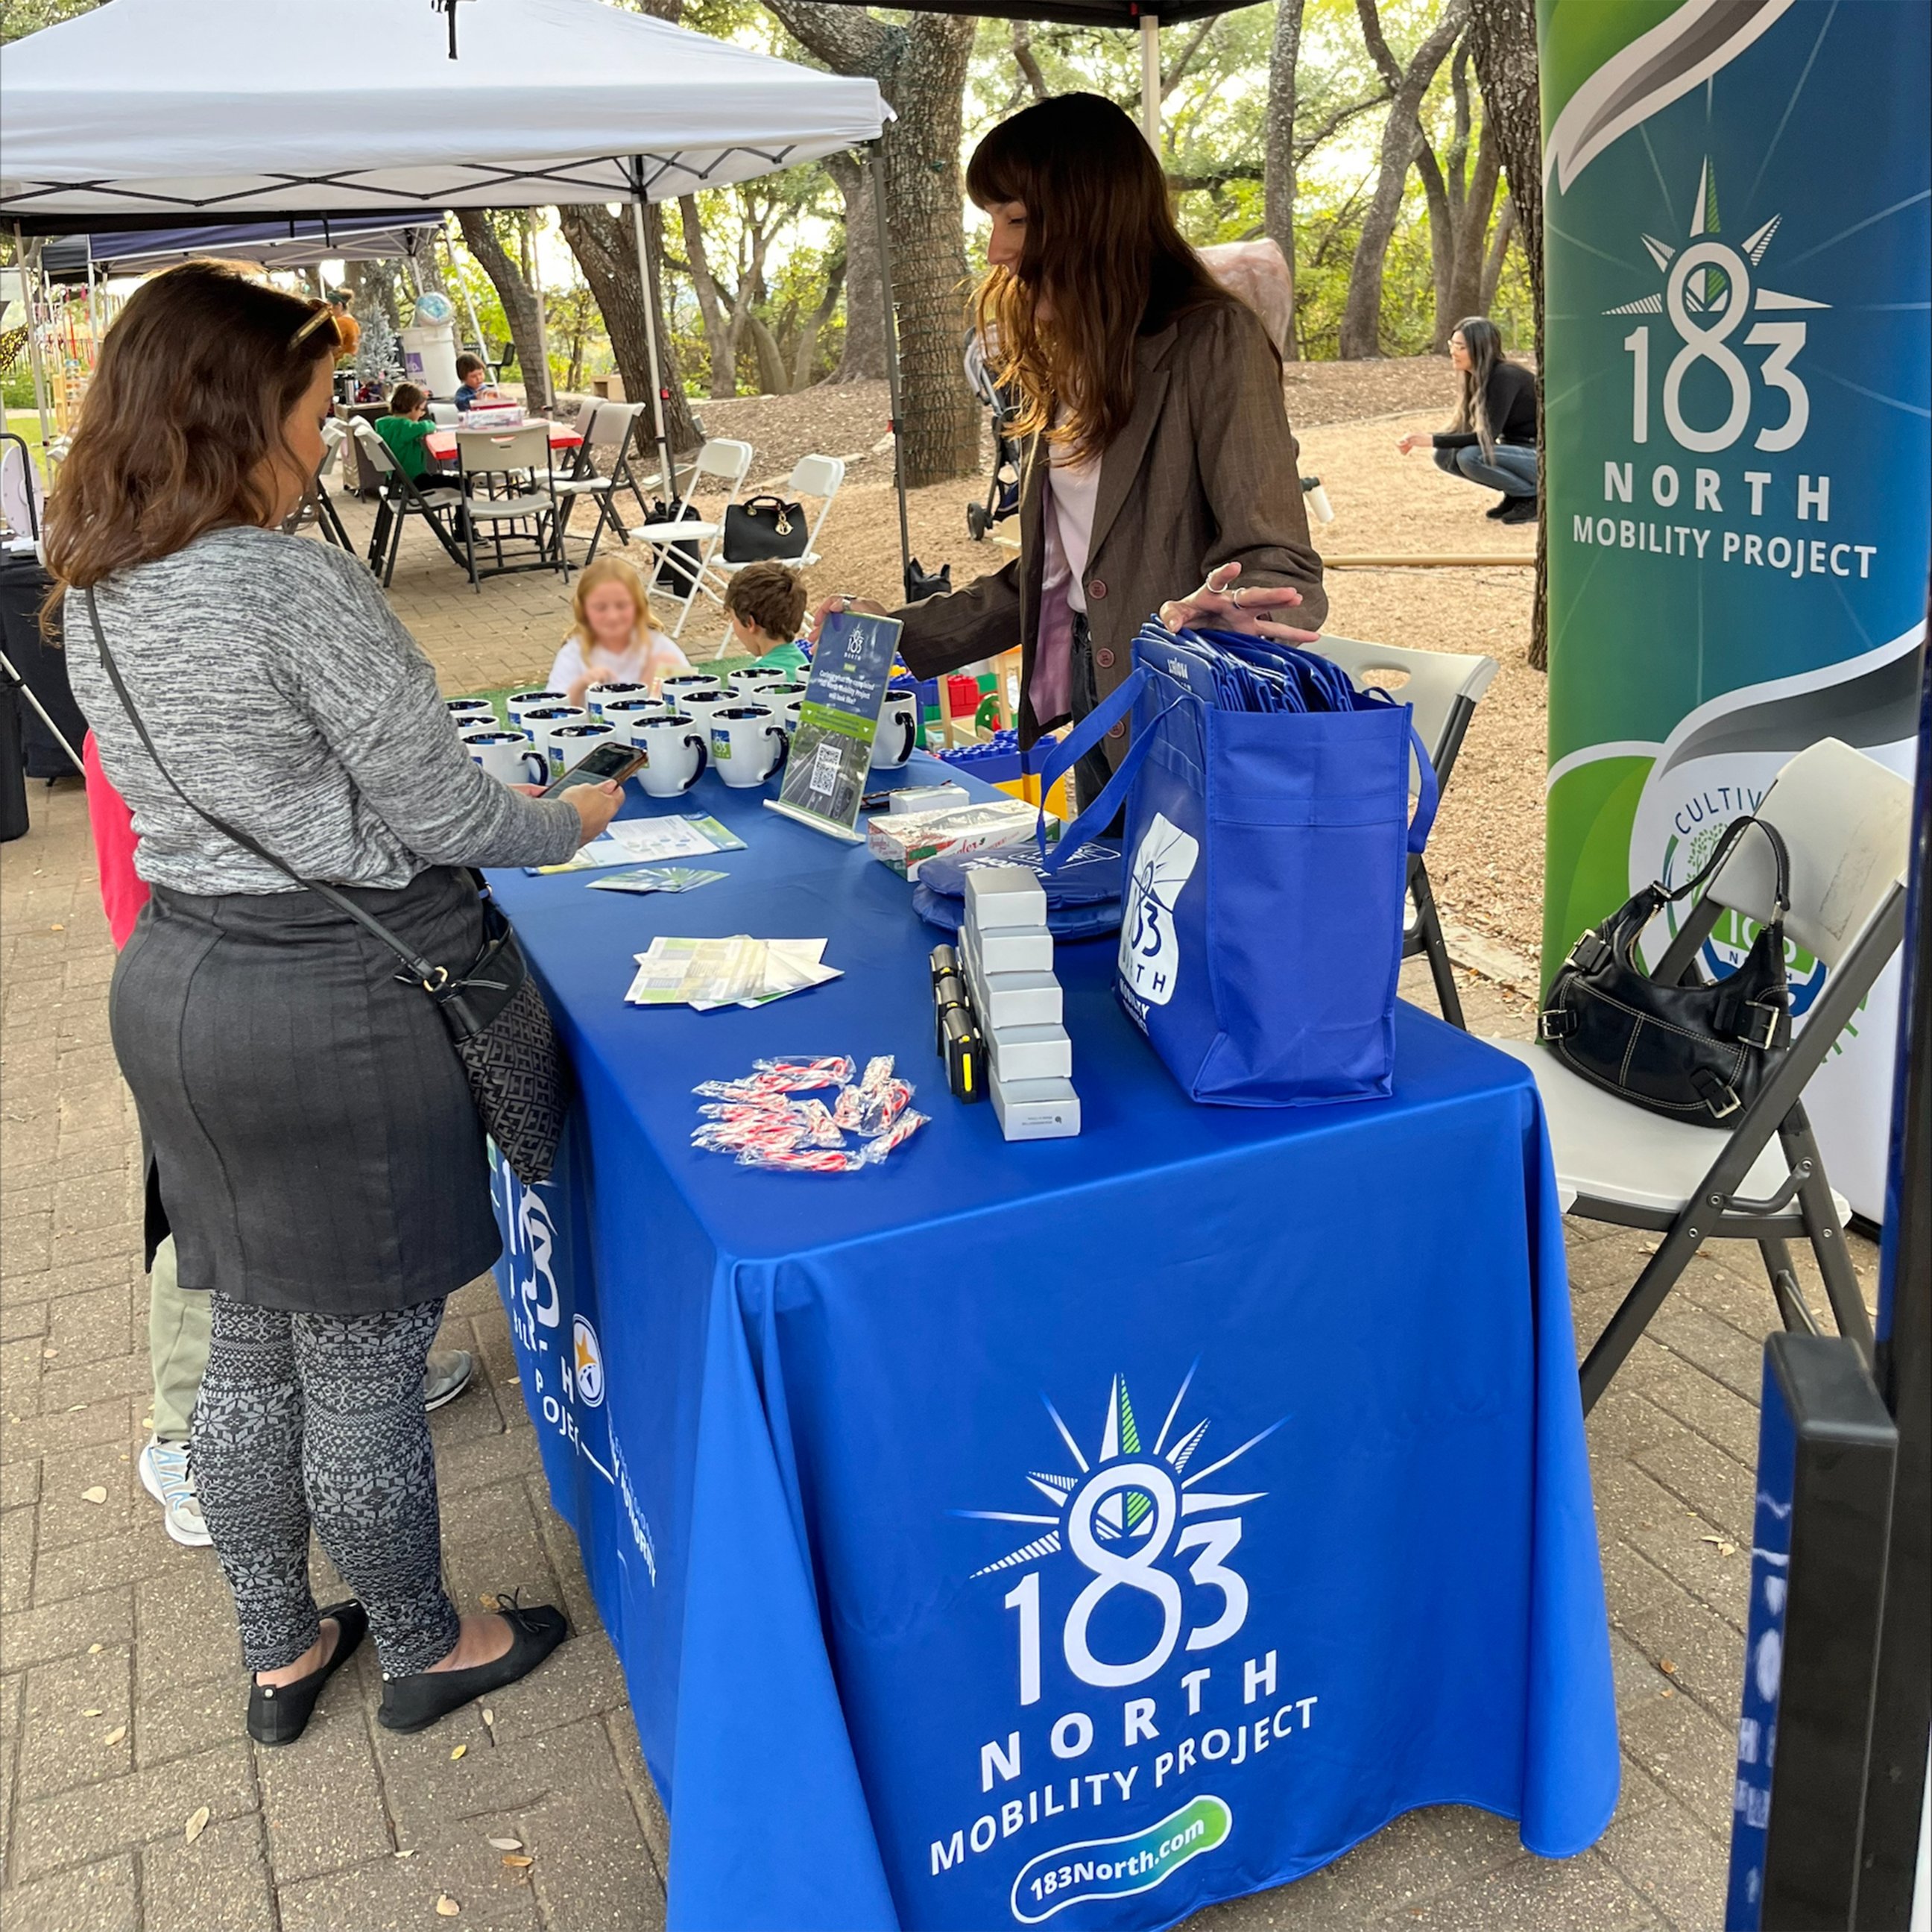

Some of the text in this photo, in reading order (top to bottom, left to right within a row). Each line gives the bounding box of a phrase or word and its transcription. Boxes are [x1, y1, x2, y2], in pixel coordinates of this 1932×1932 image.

[1624, 242, 1809, 452] 183
[1573, 515, 1877, 578] MOBILITY PROJECT
[1604, 461, 1829, 521] NORTH
[1005, 1463, 1249, 1705] 183
[930, 1696, 1318, 1875] MOBILITY PROJECT
[982, 1650, 1278, 1793] NORTH
[1032, 1818, 1205, 1902] 183North.com
